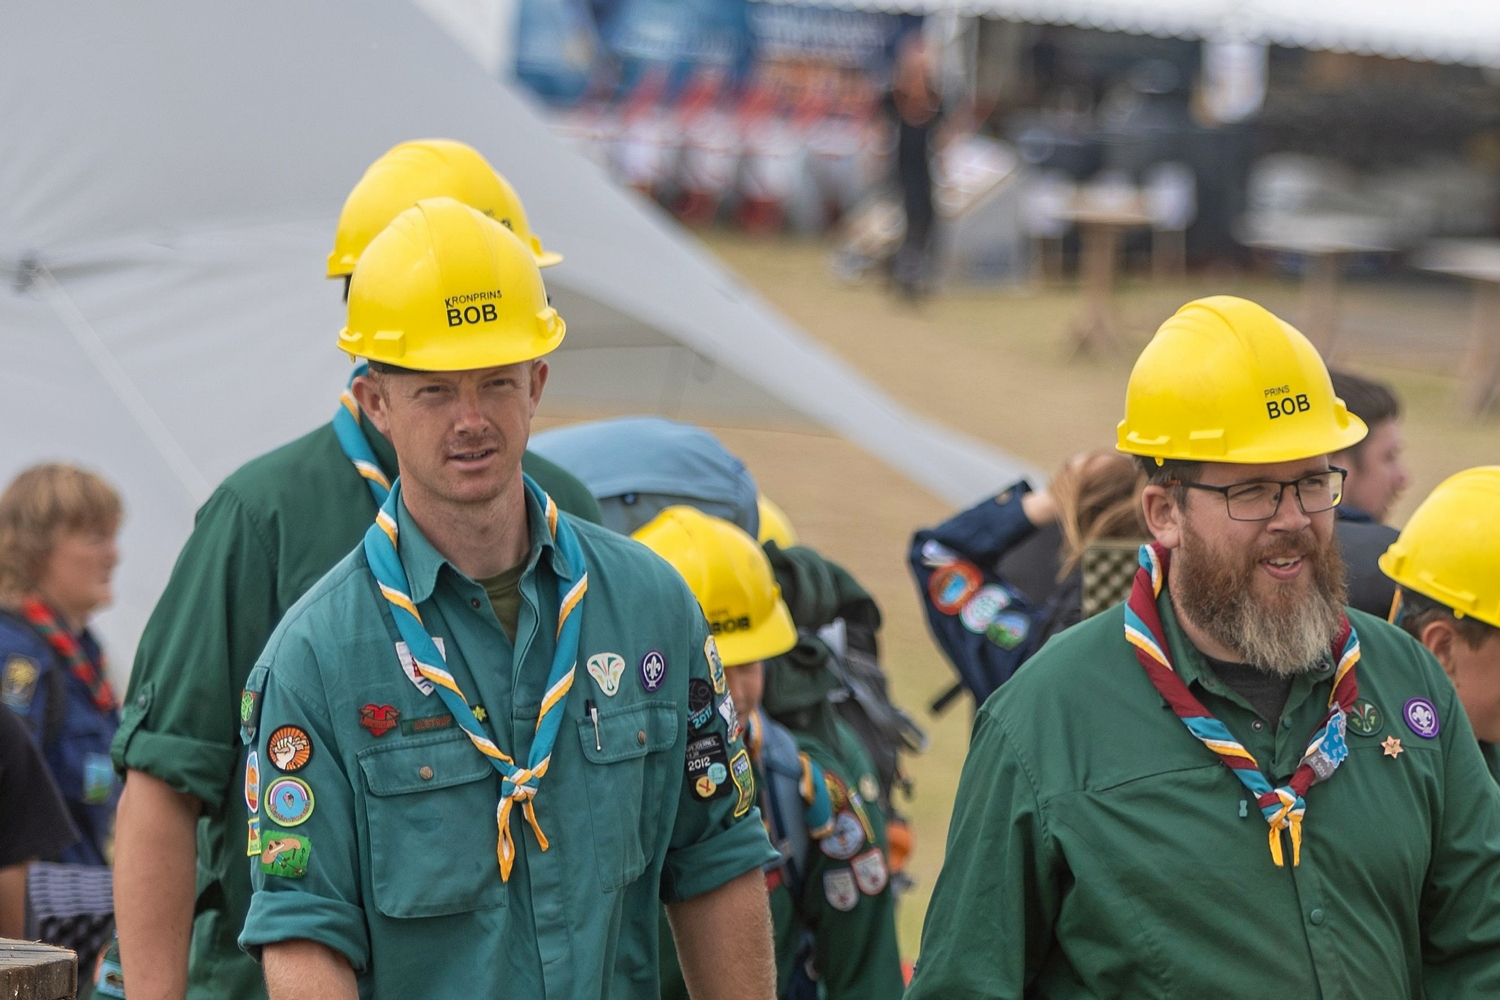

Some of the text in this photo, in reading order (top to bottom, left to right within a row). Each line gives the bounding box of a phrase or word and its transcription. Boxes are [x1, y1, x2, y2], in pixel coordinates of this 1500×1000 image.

[445, 290, 502, 308] KRONPRINS
[446, 303, 498, 328] BOB
[1264, 385, 1290, 398] PRINS
[1266, 393, 1310, 420] BOB
[712, 615, 751, 636] BOB
[413, 717, 452, 731] ULSTRUP
[688, 756, 711, 772] 2012
